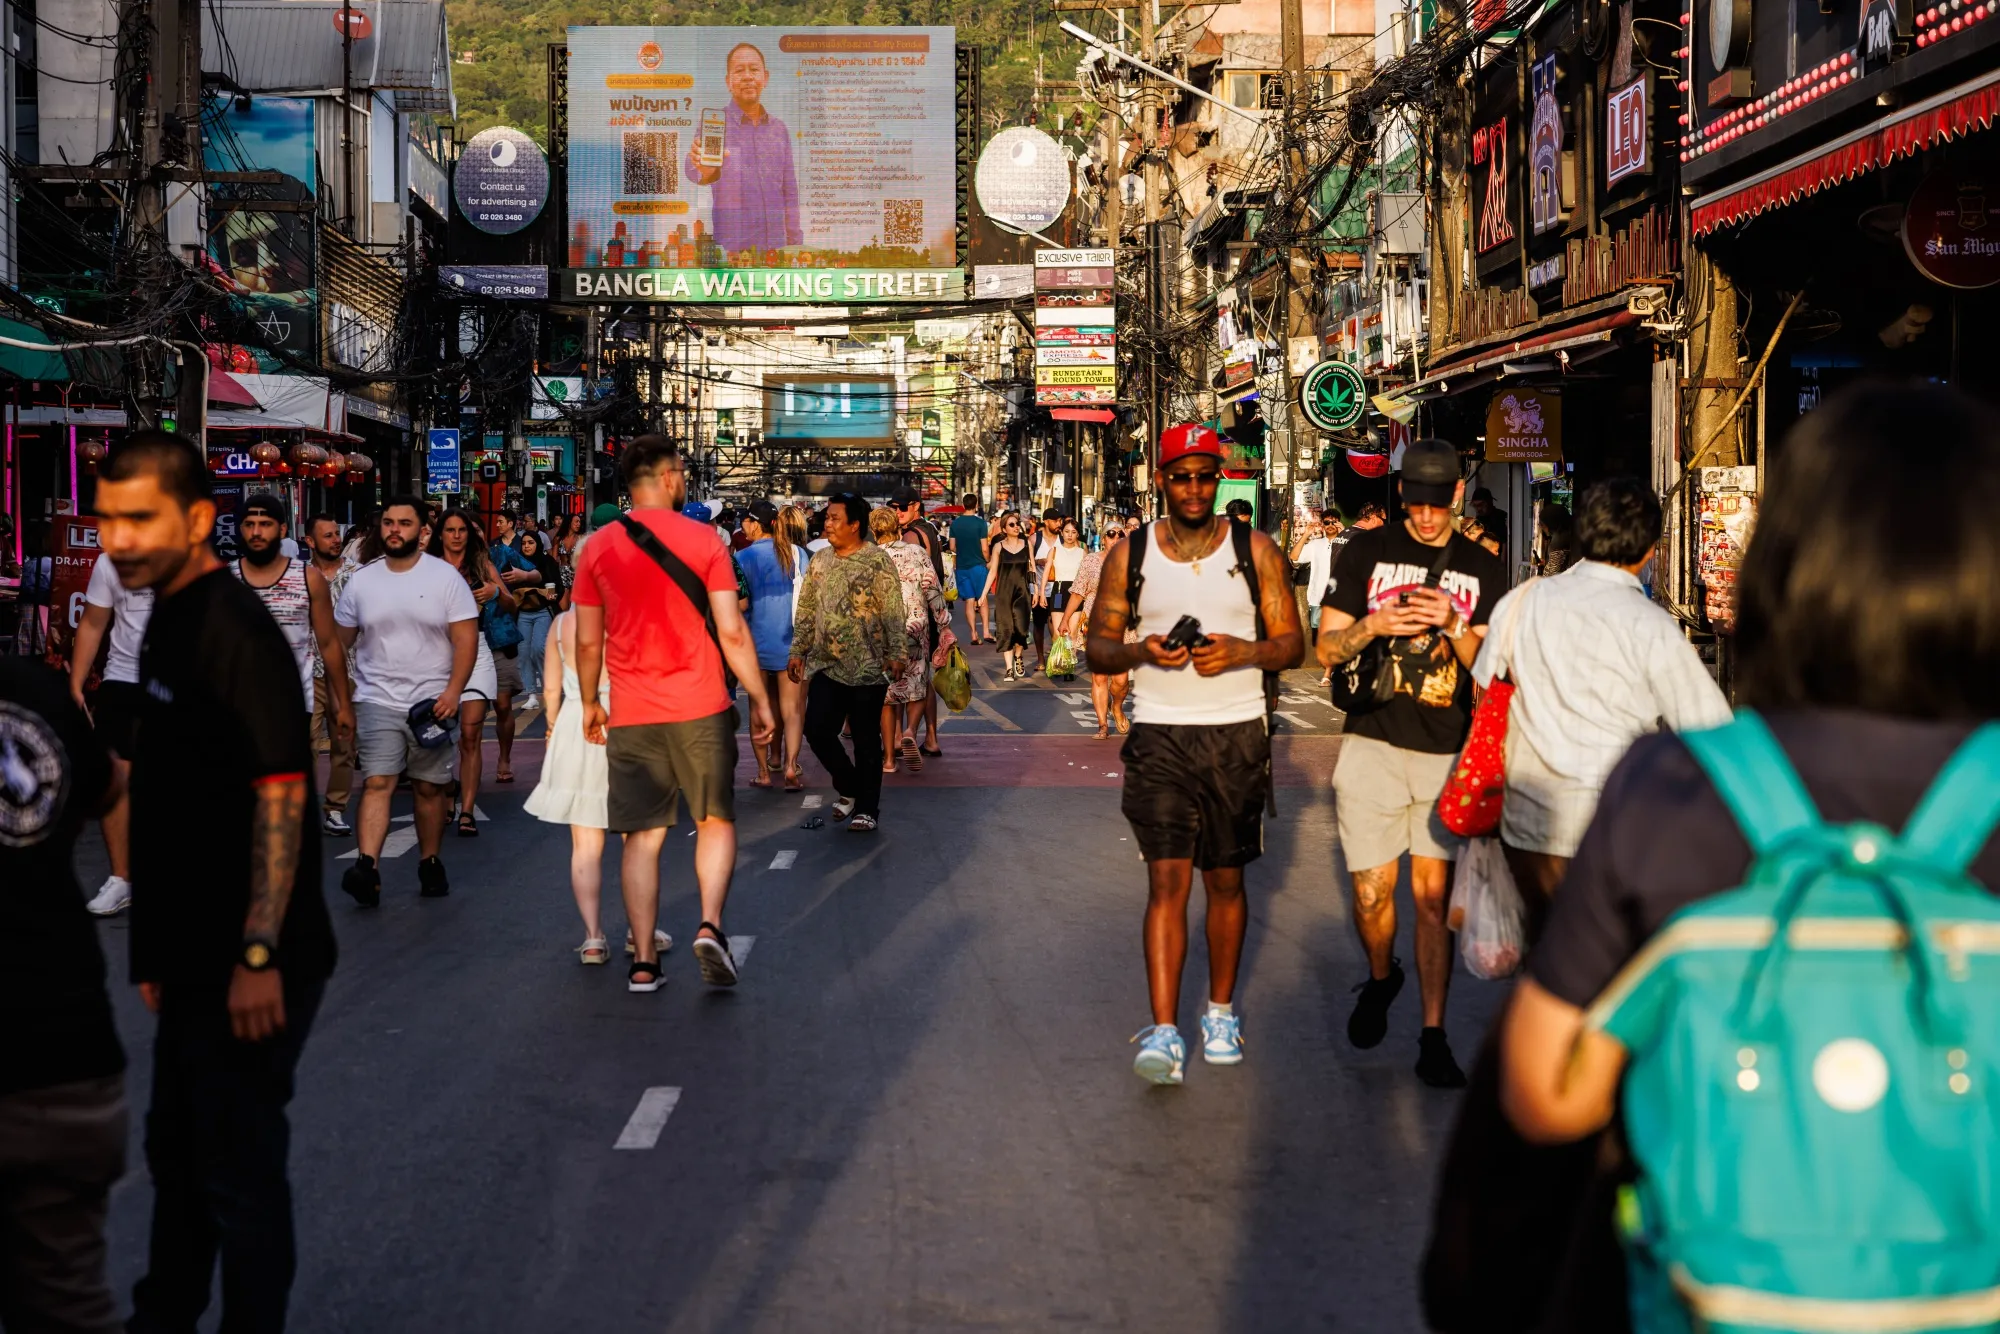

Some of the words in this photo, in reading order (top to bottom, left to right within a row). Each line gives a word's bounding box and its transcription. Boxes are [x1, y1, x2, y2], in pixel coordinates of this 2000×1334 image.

[1867, 9, 1892, 53] BAR
[867, 58, 884, 66] LINE
[894, 58, 899, 66] 2
[609, 95, 678, 112] พบปัญหา
[683, 97, 693, 110] ?
[610, 113, 646, 127] แจ้งได้
[646, 117, 692, 126] ง่ายนิดเดียว
[1609, 84, 1645, 178] LEO
[480, 182, 513, 191] Contact
[468, 197, 480, 205] for
[481, 197, 527, 207] advertising
[988, 197, 1000, 206] for
[1925, 239, 1959, 256] San
[481, 286, 493, 294] 02
[494, 286, 511, 294] 026
[513, 286, 536, 294] 3480
[575, 272, 692, 297] BANGLA
[699, 272, 834, 297] WALKING
[843, 272, 950, 297] STREET
[1311, 368, 1332, 390] CANNABIS
[1332, 367, 1348, 376] STORE
[1347, 373, 1362, 392] PHUKET
[1312, 402, 1320, 415] HIGH
[1320, 414, 1339, 424] QUALITY
[1340, 403, 1360, 424] PRODUCTS
[922, 423, 940, 432] Chang
[1497, 437, 1549, 448] SINGHA
[208, 446, 236, 454] urrency
[1322, 450, 1337, 460] ang
[212, 487, 241, 495] URRENCY
[1332, 536, 1350, 545] umbr
[55, 556, 94, 568] DRAFT
[1370, 561, 1429, 601] TRAVIS
[1438, 570, 1481, 611] COTT
[68, 591, 87, 629] 6
